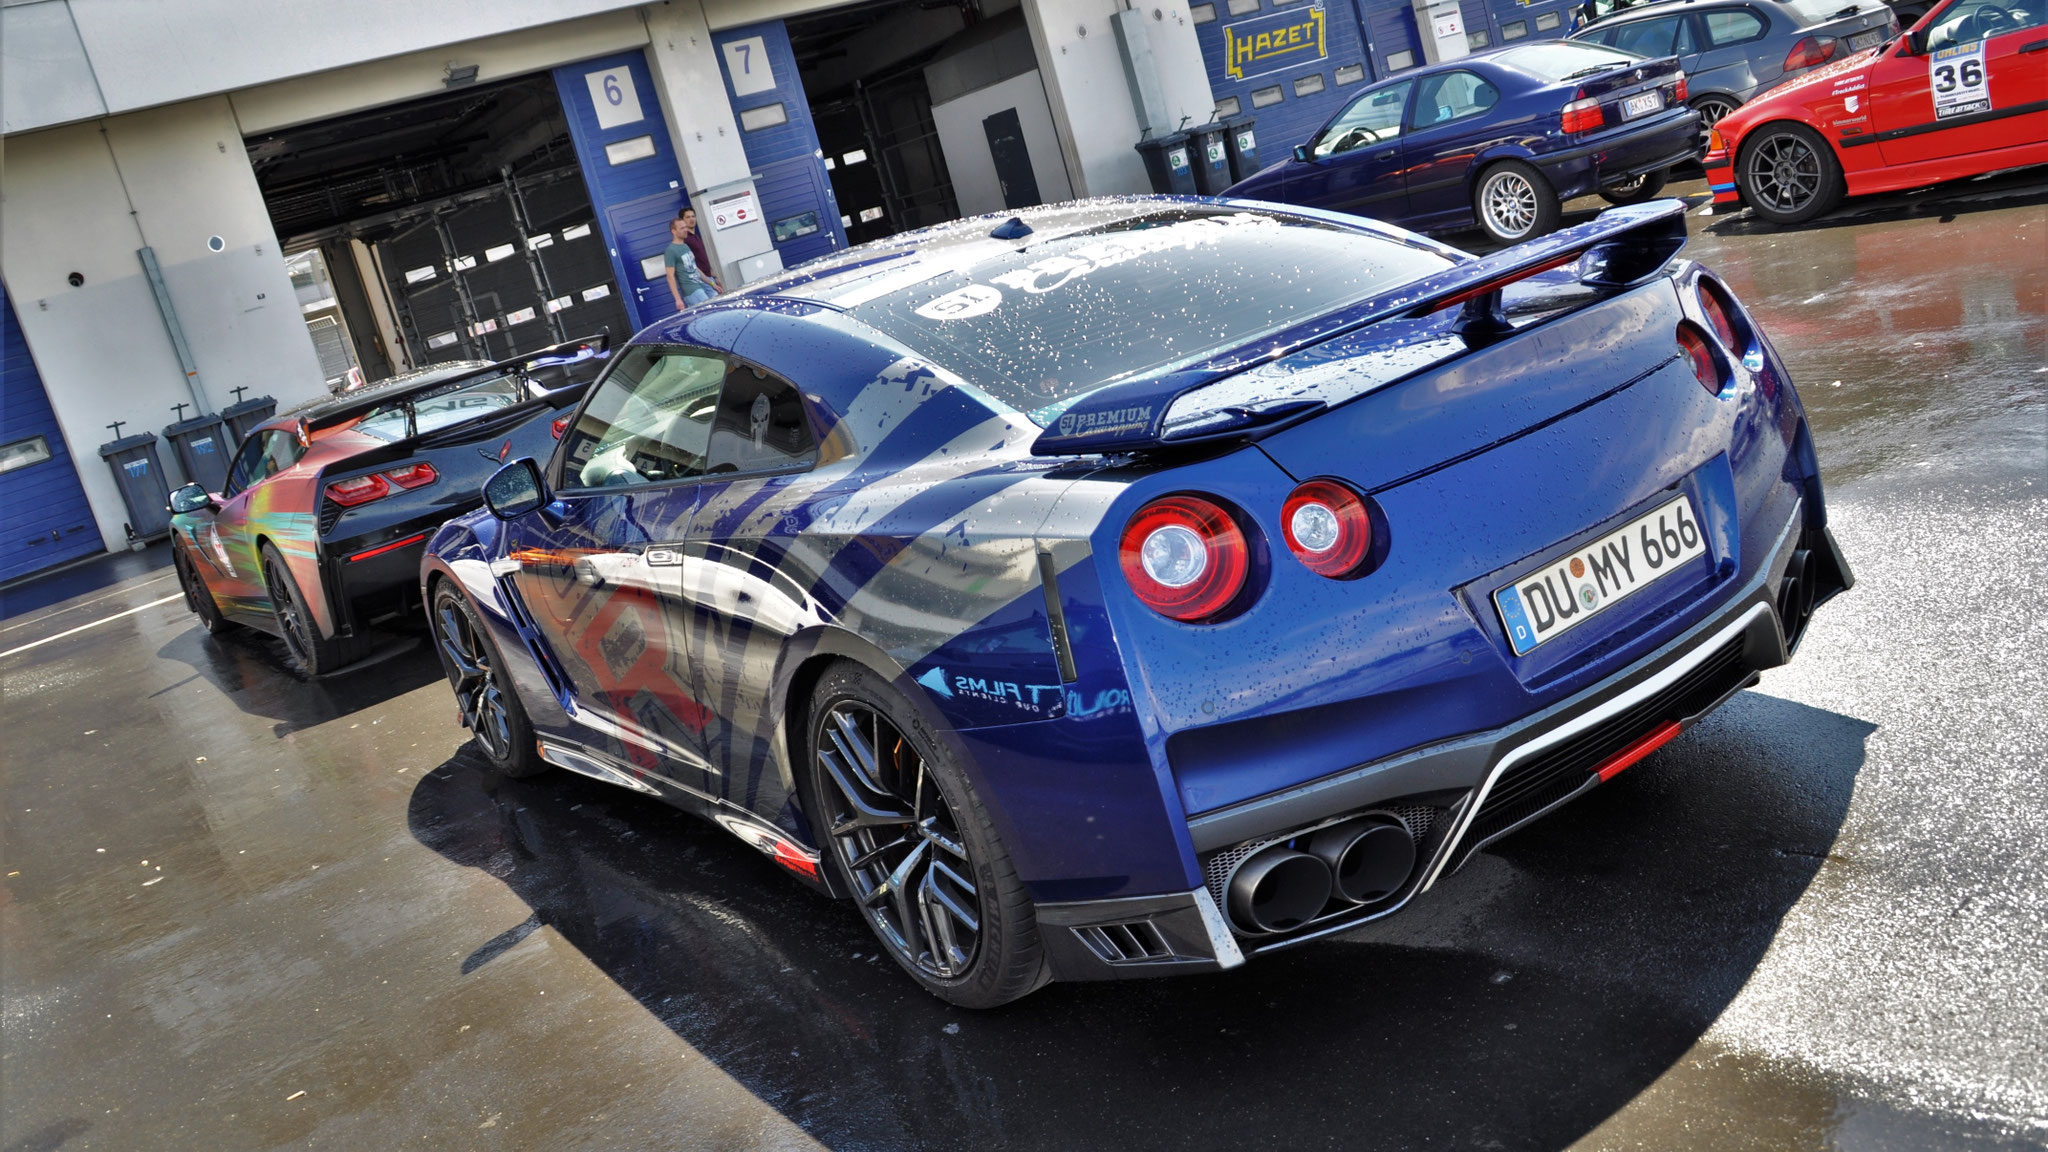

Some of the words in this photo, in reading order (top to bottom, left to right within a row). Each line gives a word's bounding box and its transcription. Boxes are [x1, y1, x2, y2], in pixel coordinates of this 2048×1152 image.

[1236, 21, 1315, 64] HAZET
[734, 43, 751, 75] 7
[603, 74, 623, 106] 6
[1934, 58, 1983, 94] 36
[1076, 406, 1153, 428] PREMIUM
[1522, 567, 1580, 634] DU
[1587, 535, 1635, 599] MY
[1640, 505, 1699, 570] 666
[1515, 624, 1527, 640] D
